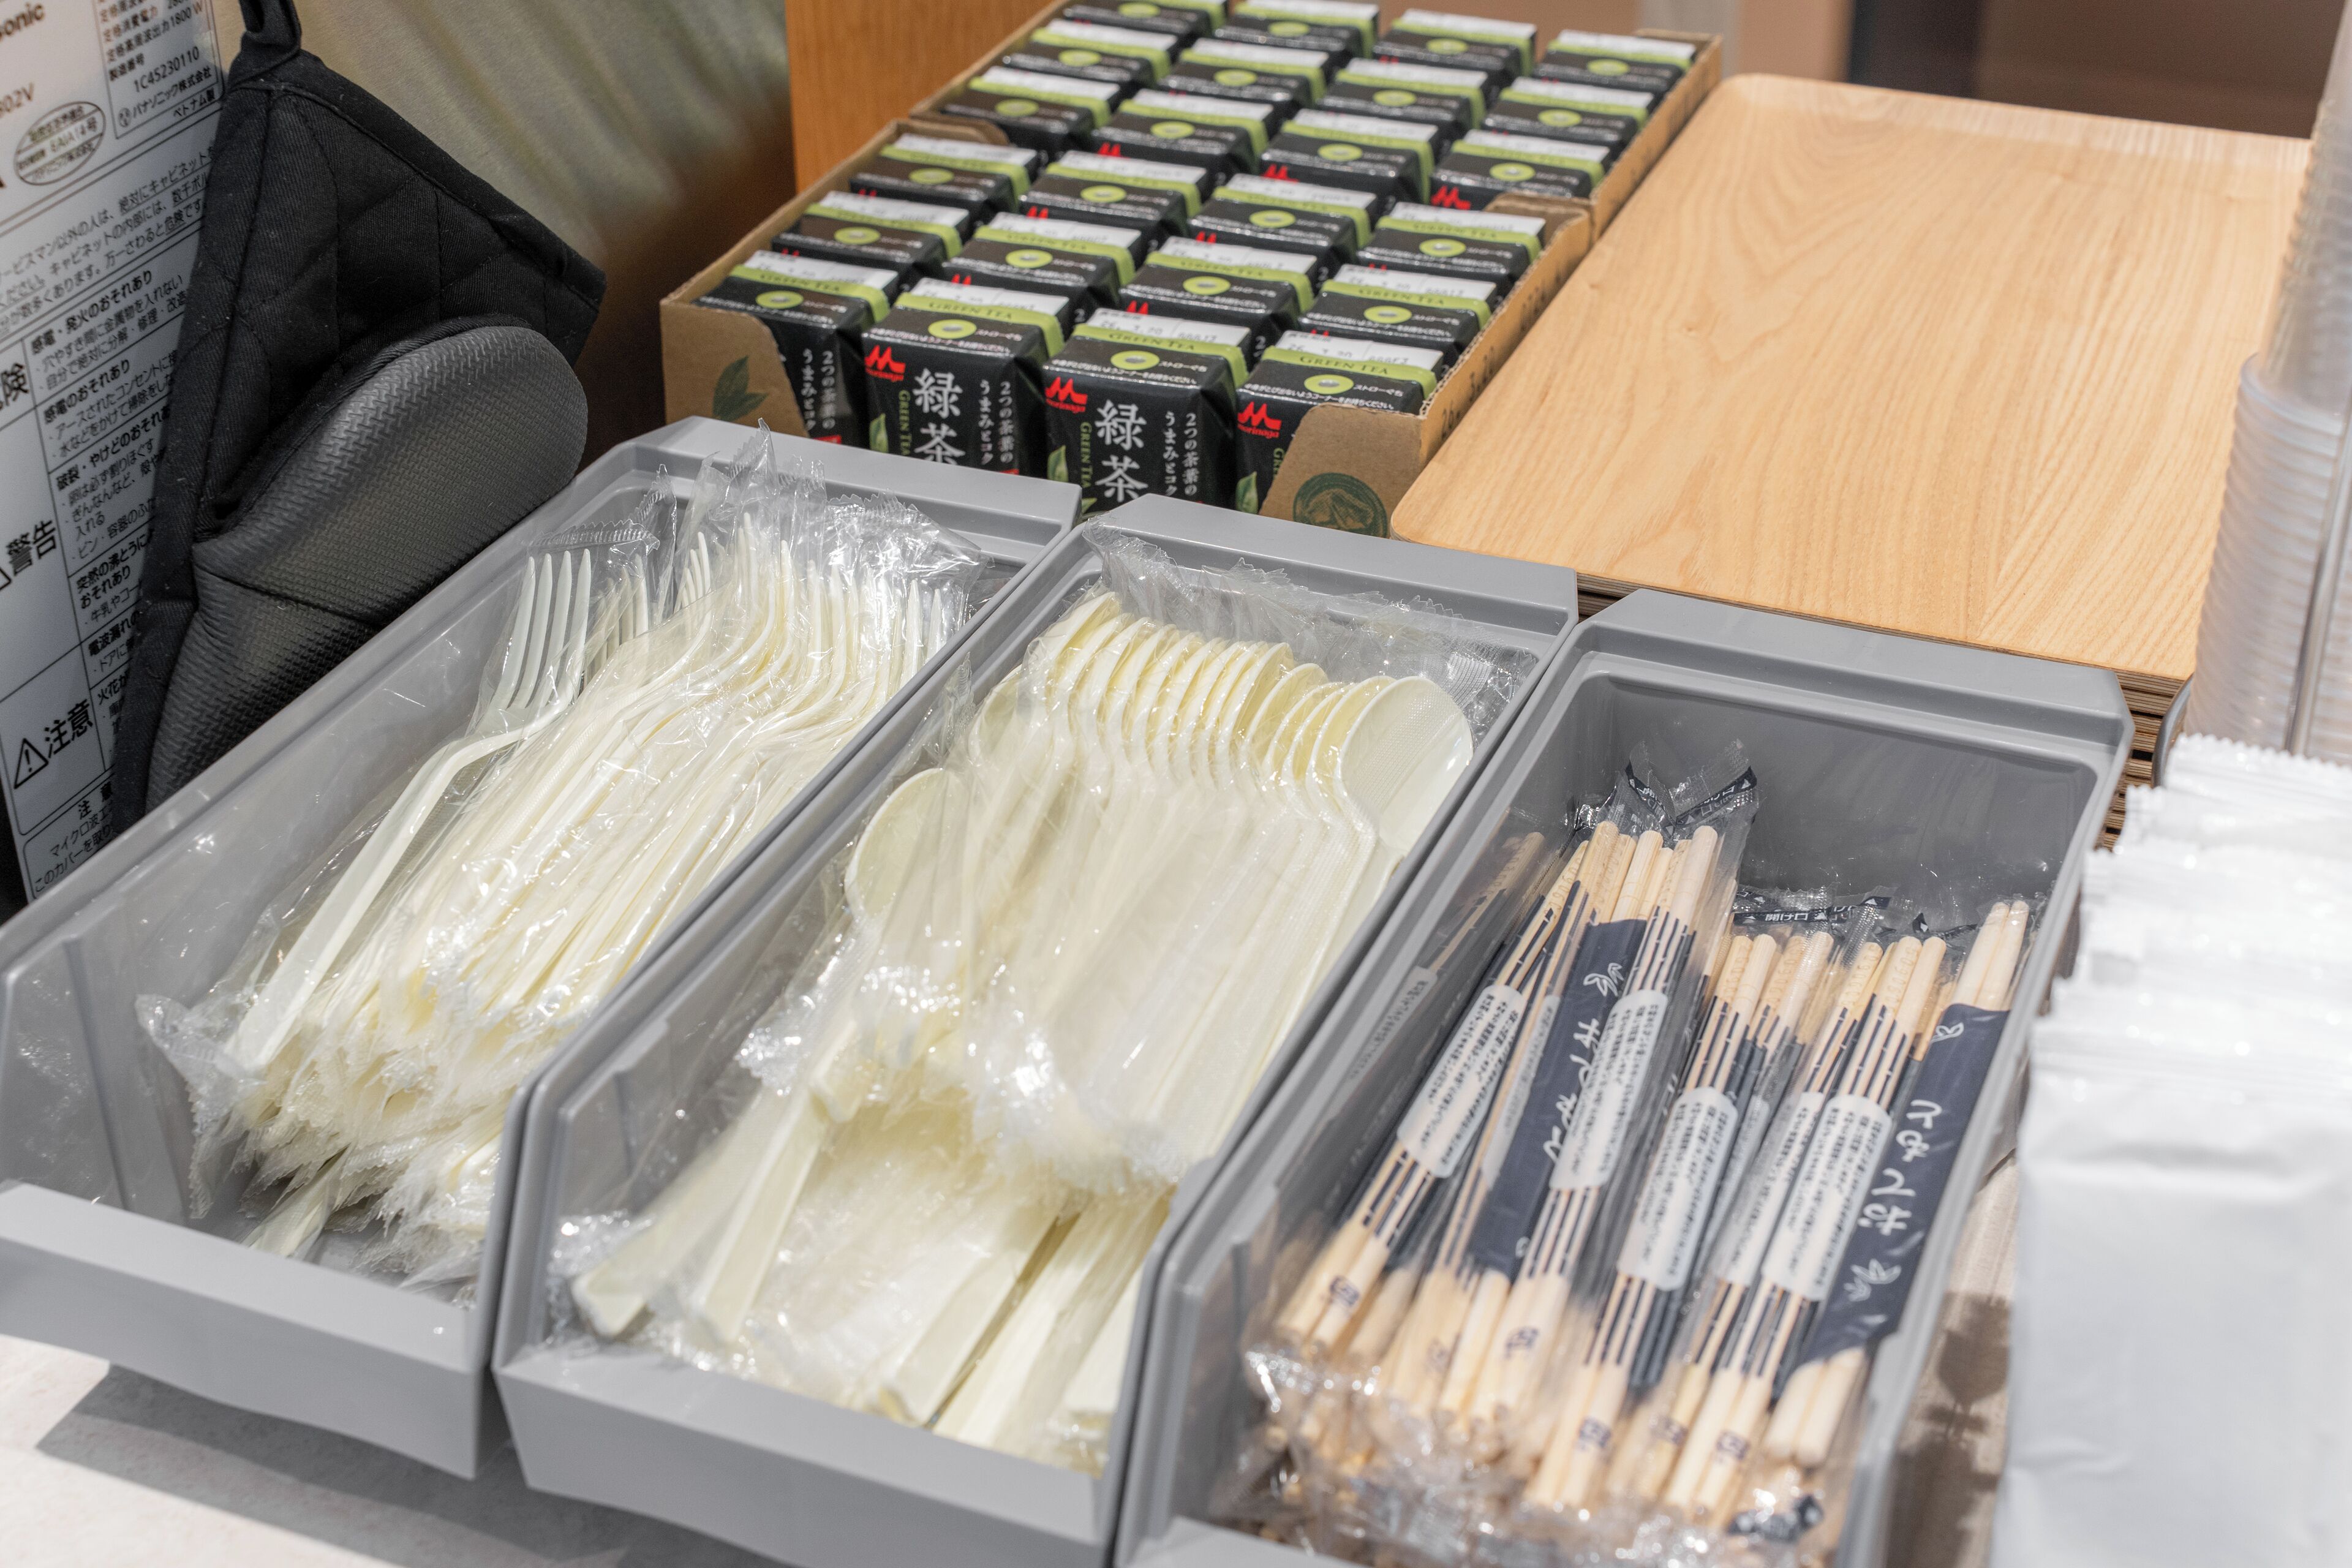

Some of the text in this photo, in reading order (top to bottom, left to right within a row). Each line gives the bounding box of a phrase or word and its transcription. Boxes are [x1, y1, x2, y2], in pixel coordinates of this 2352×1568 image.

[173, 89, 216, 118] ベトナム製
[1109, 332, 1196, 351] GREEN TEA
[1299, 356, 1389, 375] GREEN TEA
[0, 363, 29, 409] 険
[43, 360, 130, 424] 感電のおそれあり
[912, 368, 966, 464] 緑茶
[899, 390, 912, 456] GREEN TEA
[978, 379, 995, 466] うまみとコク
[998, 380, 1014, 464] 2つの茶葉の
[1095, 399, 1149, 502] 緑茶
[1163, 410, 1180, 497] うまみとコク
[1182, 412, 1200, 496] 2つの茶葉の
[1080, 421, 1093, 489] GREEN TEA
[6, 520, 57, 577] 警告
[75, 511, 106, 541] 入れる
[80, 565, 130, 609] おそれあり
[43, 699, 93, 759] 注意
[1764, 911, 1809, 922] 開け口
[1858, 1099, 1943, 1236] おてもと
